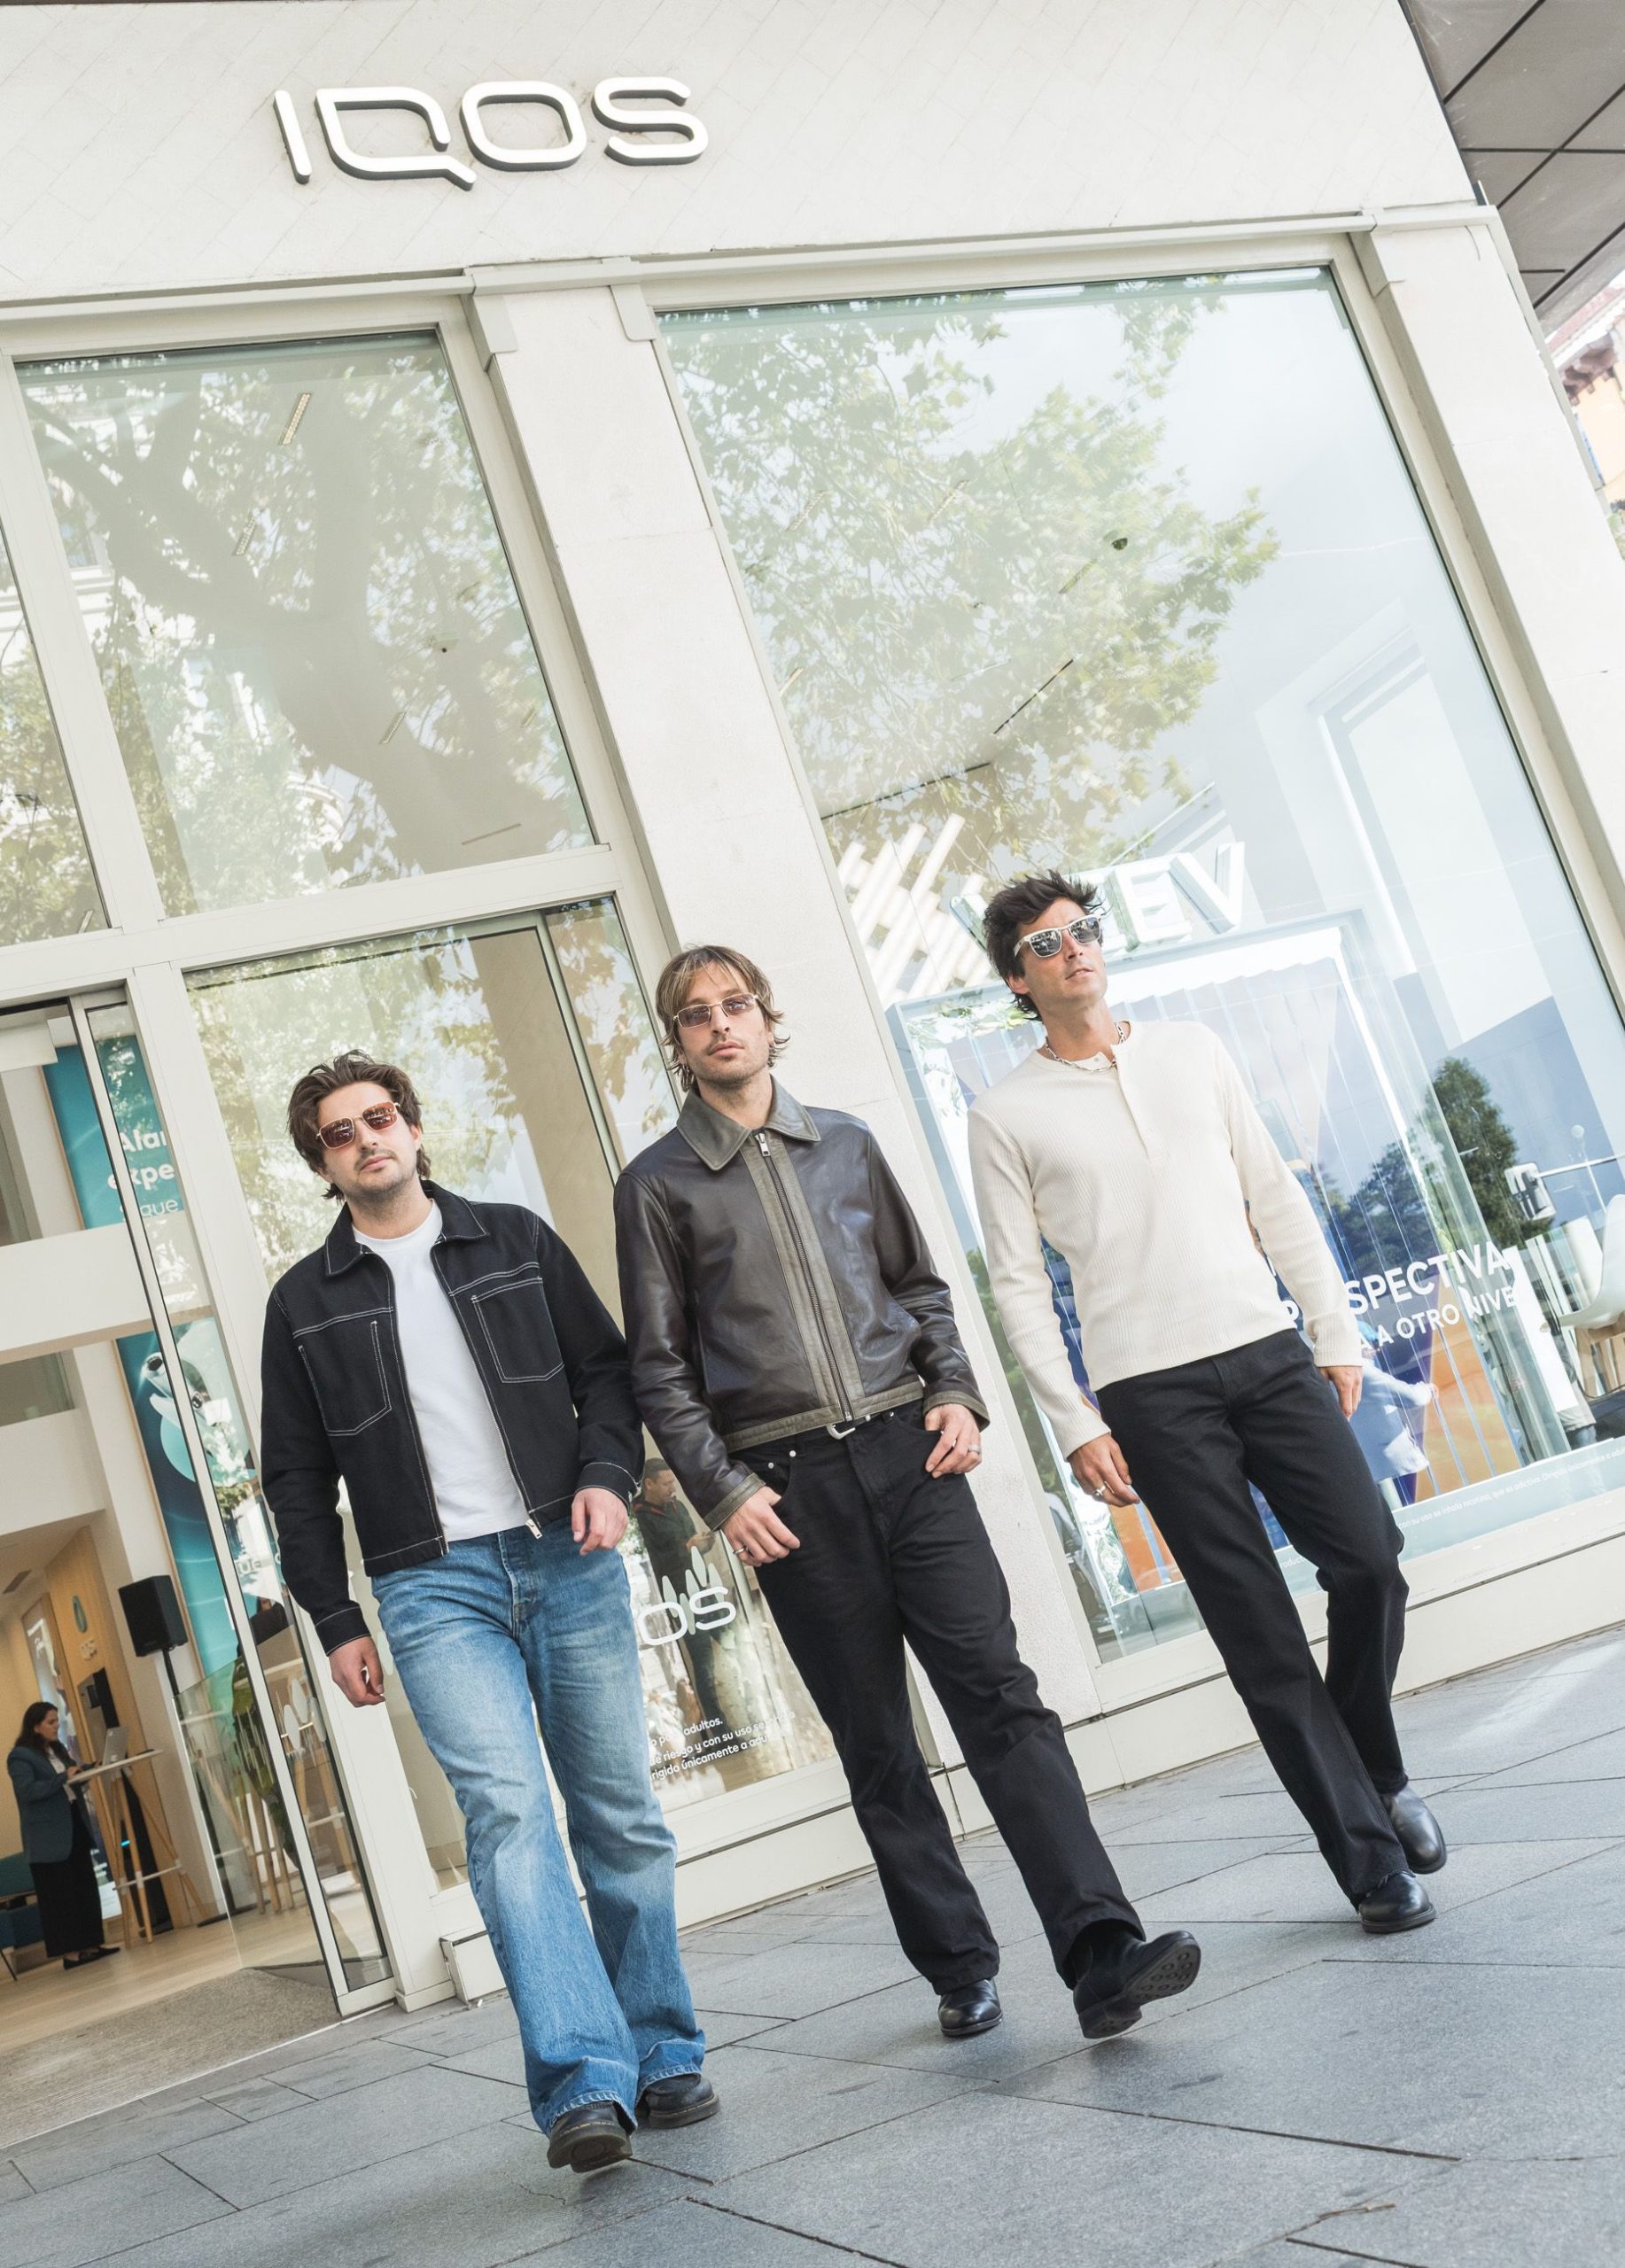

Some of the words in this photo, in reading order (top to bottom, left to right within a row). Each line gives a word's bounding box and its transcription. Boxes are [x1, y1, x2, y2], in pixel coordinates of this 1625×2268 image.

[273, 76, 710, 191] IQOS
[1396, 1304, 1460, 1340] OTRO
[1464, 1286, 1517, 1318] NIVE
[663, 1744, 694, 1763] riesgo
[695, 1743, 704, 1753] y
[702, 1736, 721, 1748] con
[721, 1731, 734, 1742] su
[735, 1725, 753, 1737] uso
[682, 1716, 724, 1736] adultos.
[680, 1743, 741, 1771] únicamente
